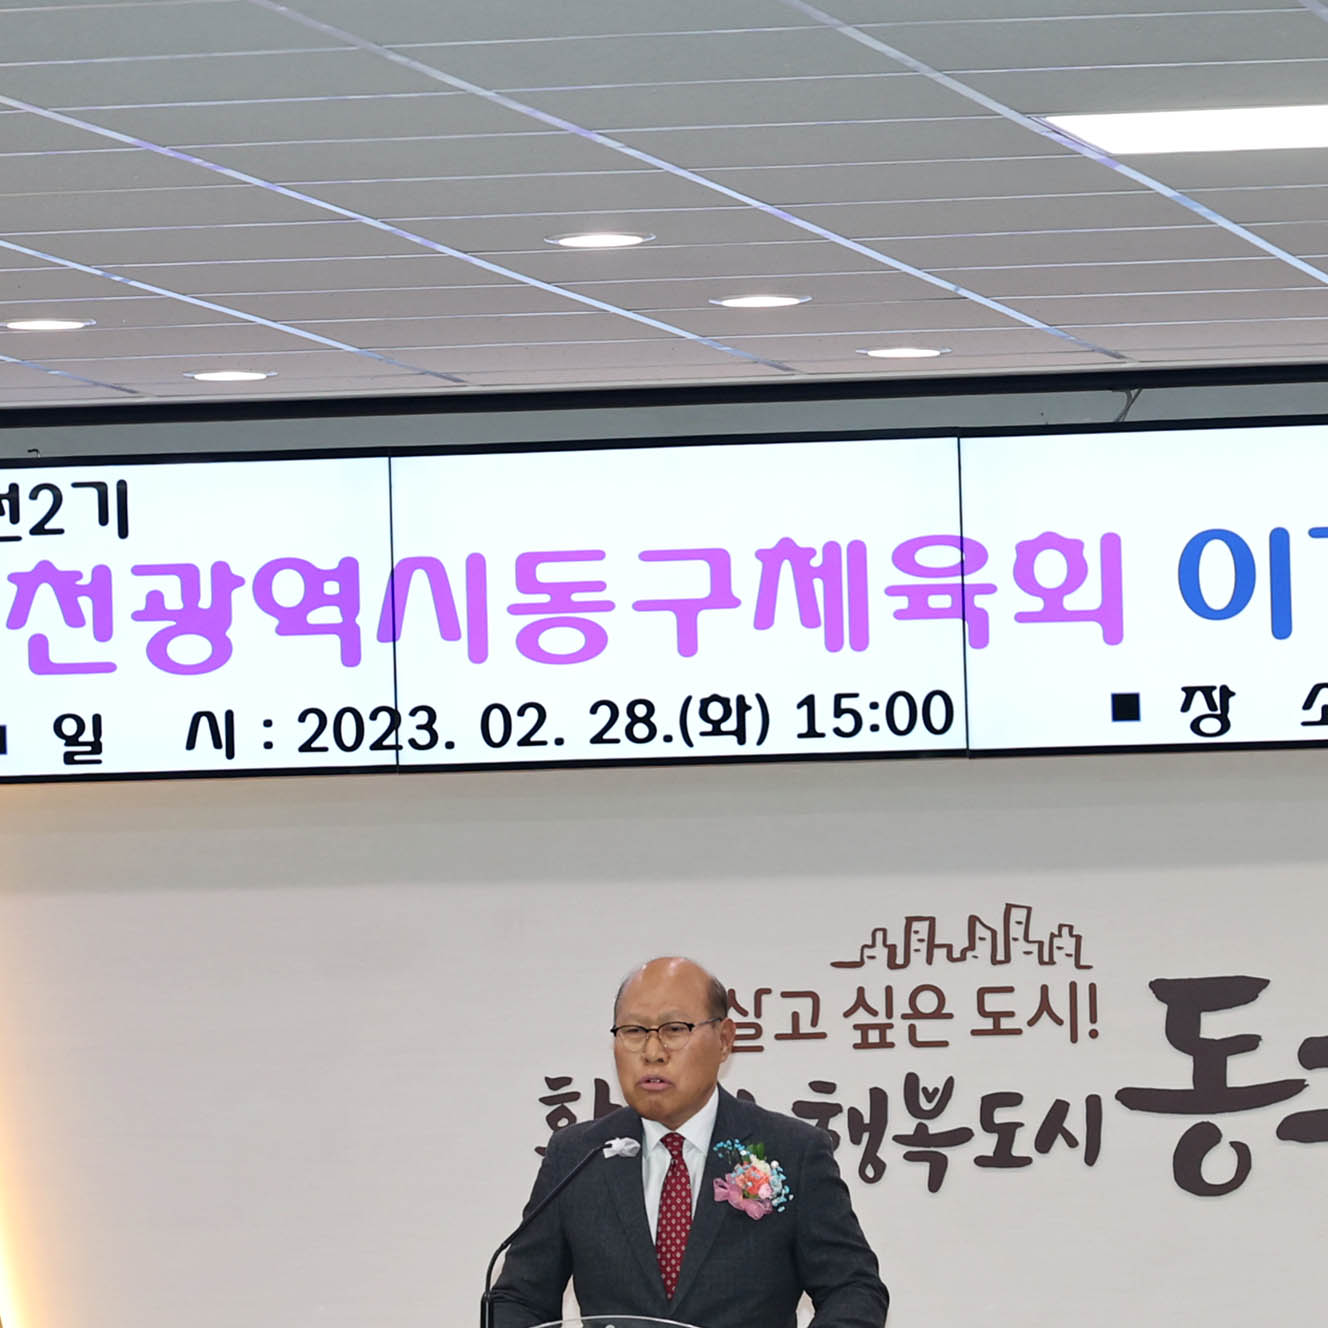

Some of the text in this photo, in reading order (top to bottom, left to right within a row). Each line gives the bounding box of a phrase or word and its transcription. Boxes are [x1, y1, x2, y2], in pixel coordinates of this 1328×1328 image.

[53, 714, 105, 765] 일
[185, 708, 235, 760] 시
[297, 704, 456, 755] 2023.
[480, 701, 565, 749] 02.
[589, 690, 772, 747] 28.(화)
[795, 689, 954, 740] 15:00
[1180, 685, 1236, 738] 장
[842, 983, 955, 1050] 싶은
[969, 980, 1100, 1043] 도시!
[791, 1071, 1103, 1194] 행복도시
